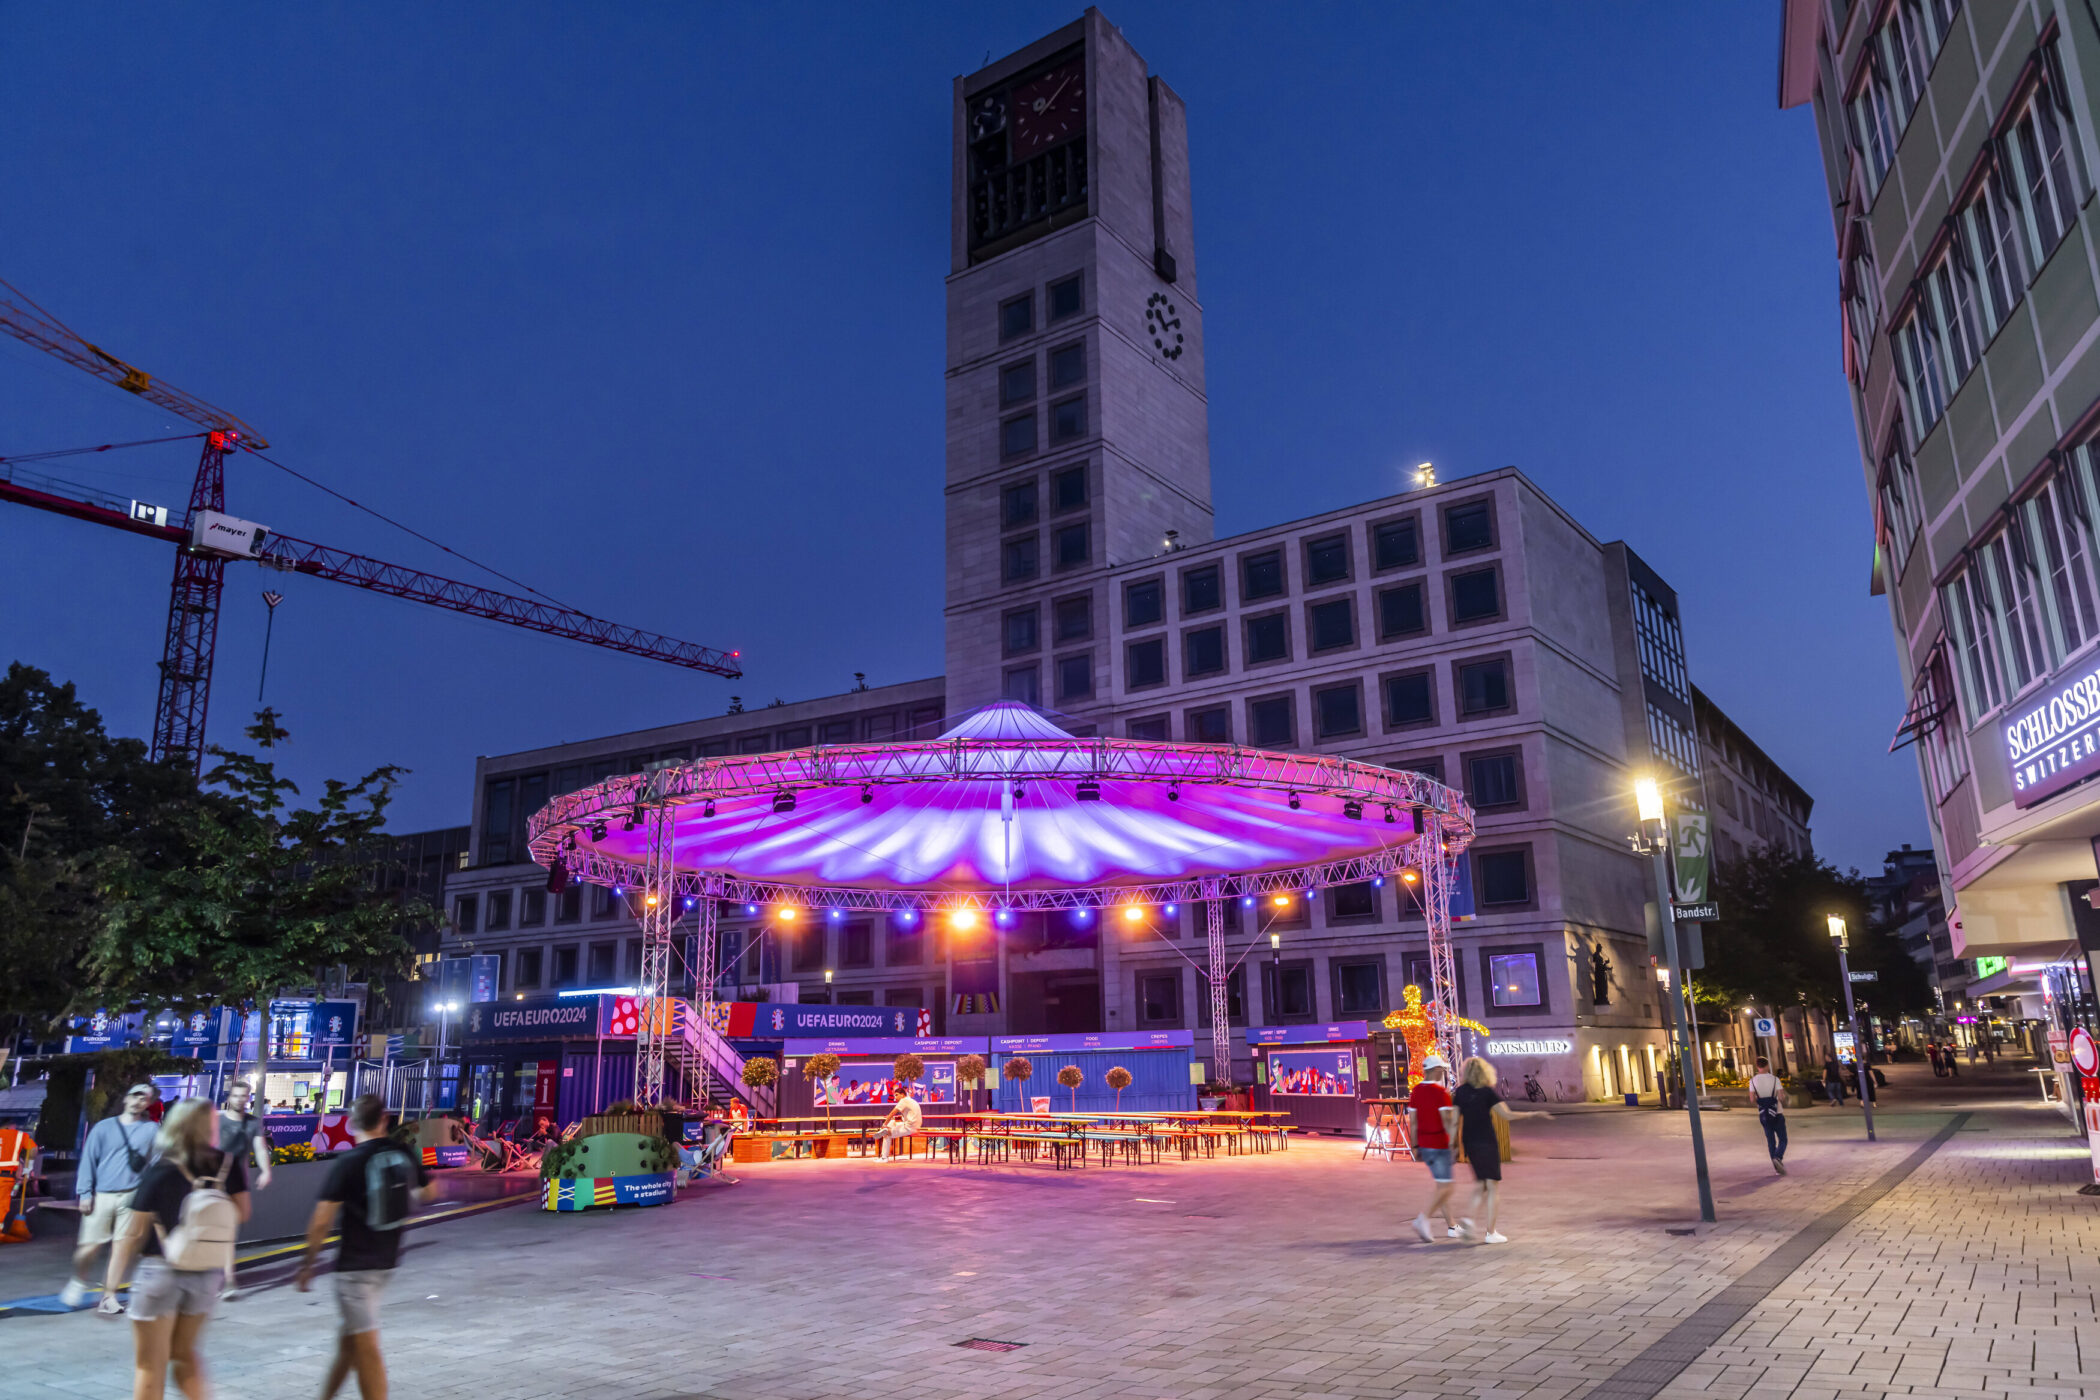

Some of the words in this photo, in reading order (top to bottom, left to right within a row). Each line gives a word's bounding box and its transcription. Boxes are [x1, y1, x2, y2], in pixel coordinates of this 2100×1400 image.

[217, 525, 247, 538] mayer
[2007, 668, 2100, 760] SCHLOSSB
[2015, 727, 2100, 791] SWITZER
[1676, 906, 1716, 919] Bandstr.
[1489, 1042, 1561, 1055] RATSKELLER
[624, 1184, 640, 1192] The
[640, 1189, 667, 1198] stadium
